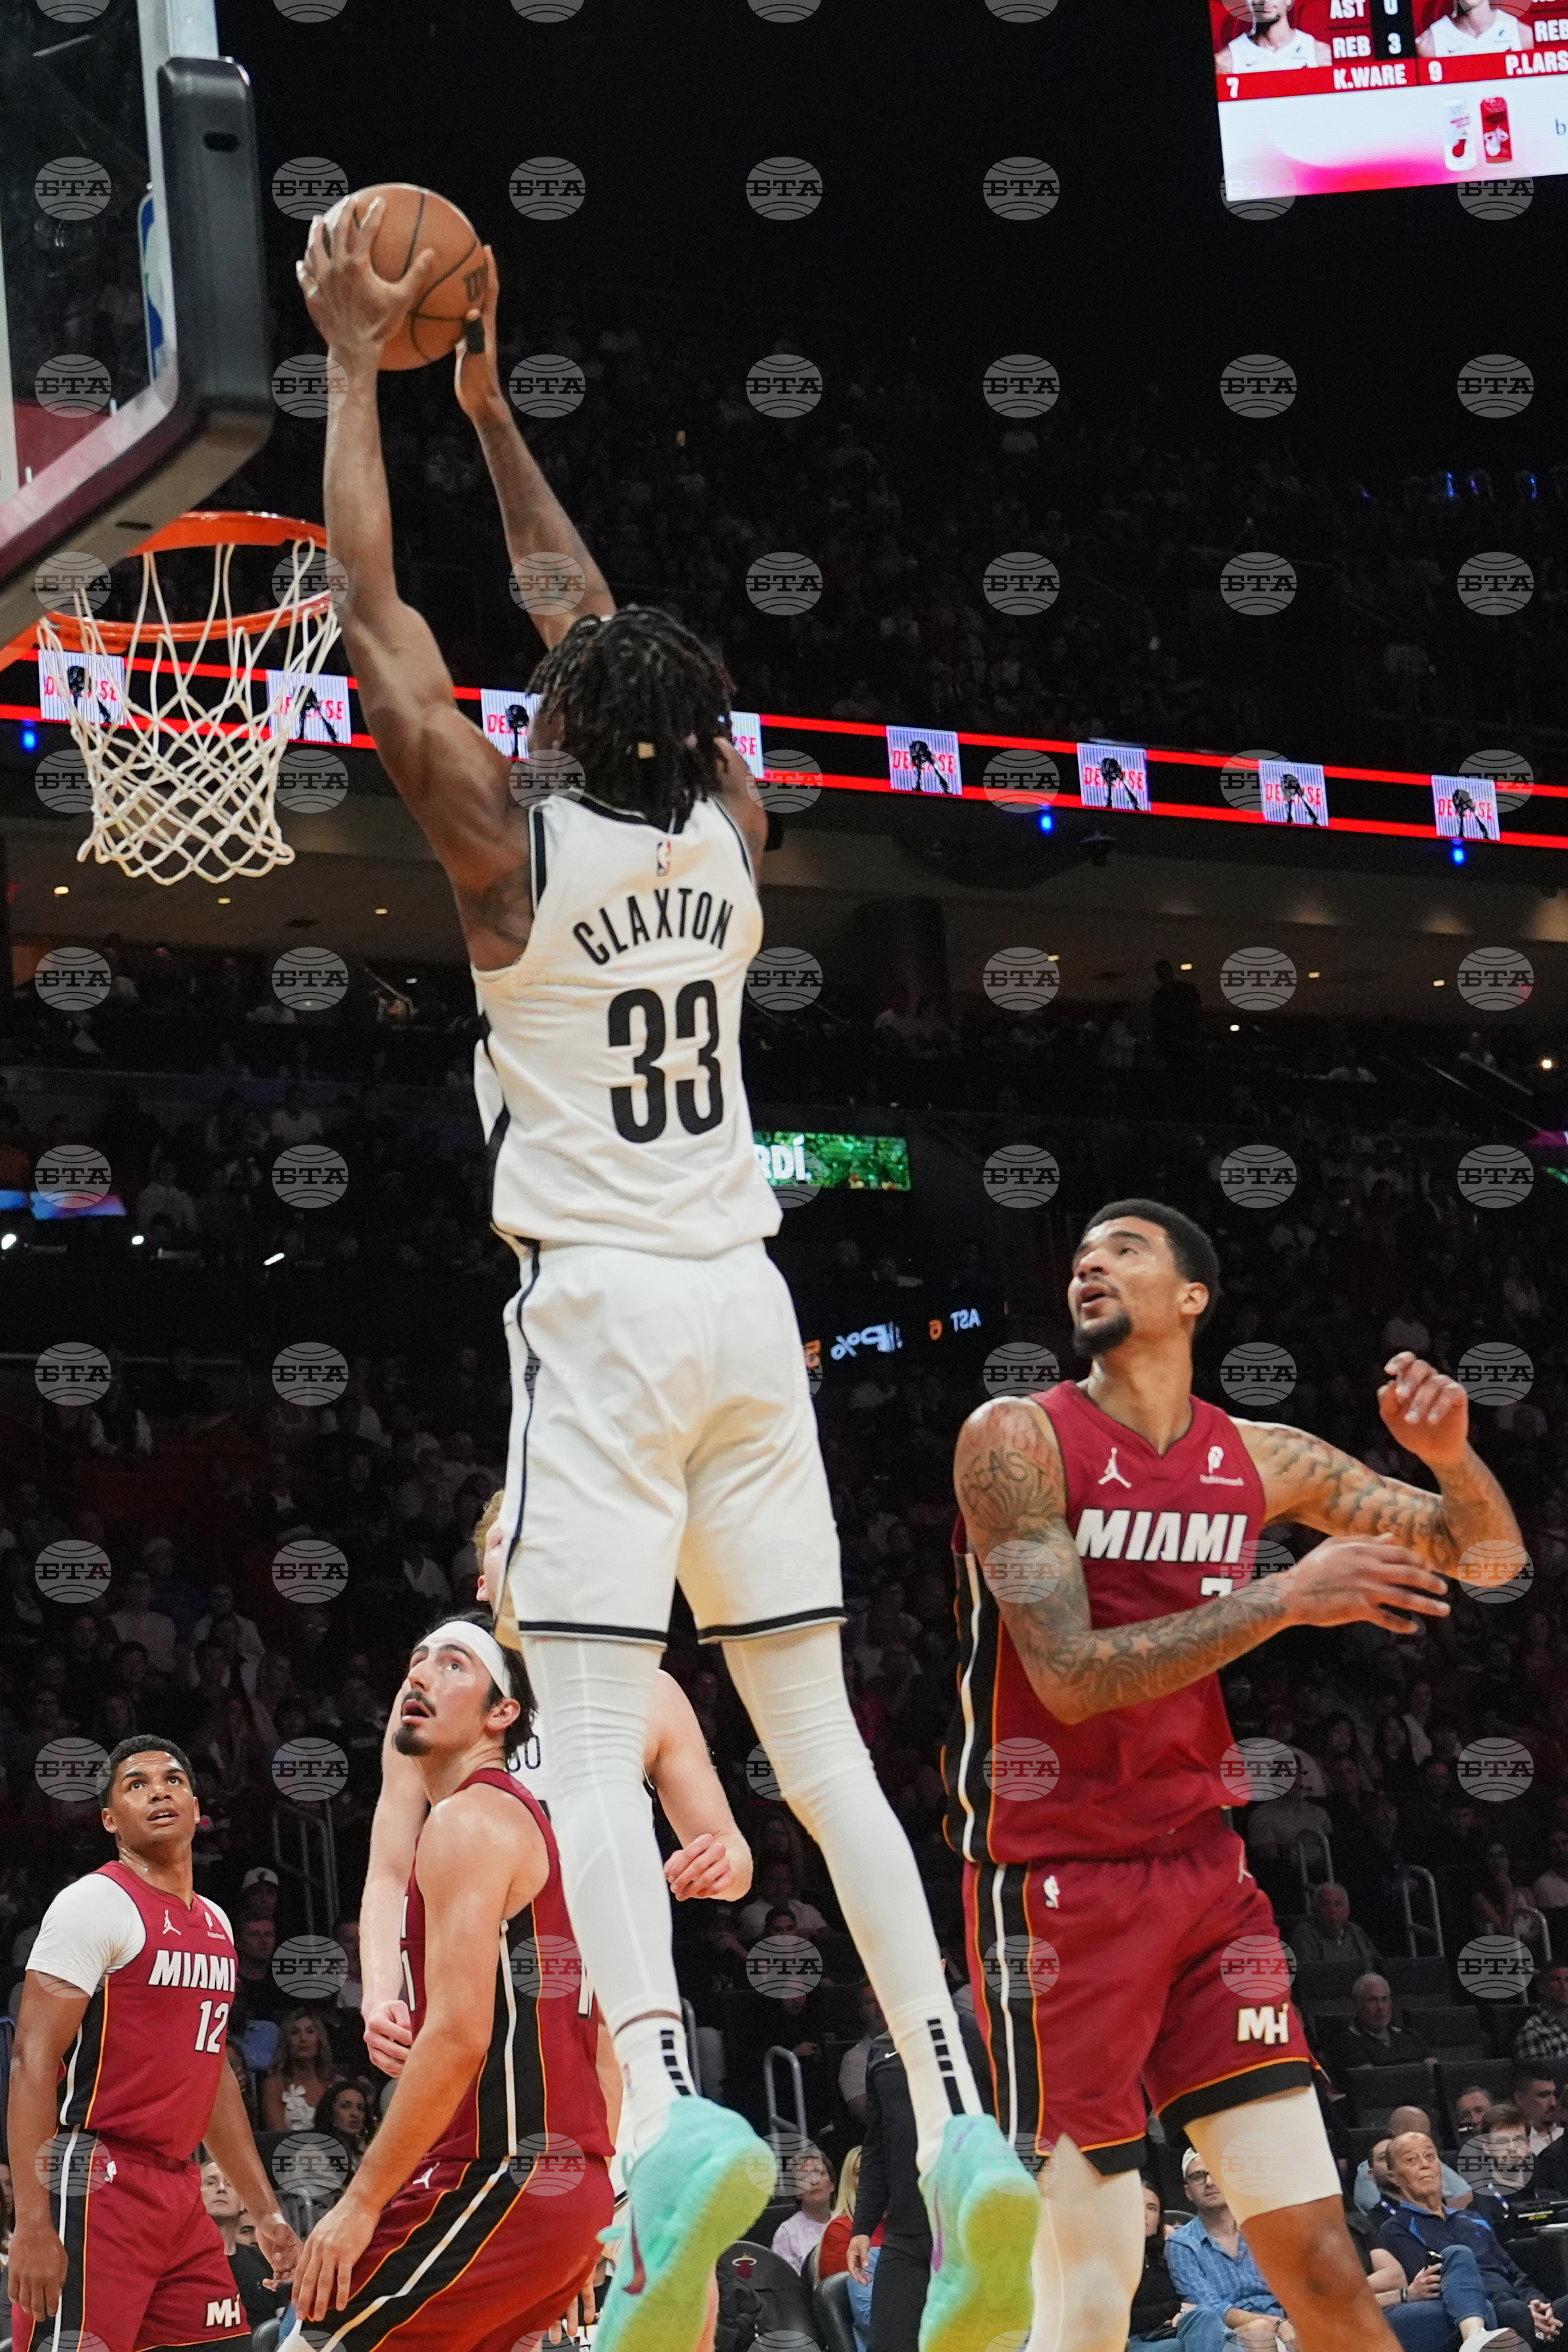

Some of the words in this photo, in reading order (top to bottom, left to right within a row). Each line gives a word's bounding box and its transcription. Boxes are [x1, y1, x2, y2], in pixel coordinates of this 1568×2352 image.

[1330, 0, 1366, 19] AST
[1332, 35, 1371, 59] REB
[1387, 32, 1402, 55] 3
[1534, 18, 1568, 42] REB
[1226, 77, 1239, 98] 7
[1333, 63, 1407, 90] K.WARE
[1428, 61, 1443, 82] 9
[572, 888, 734, 966] CLAXTON
[607, 980, 724, 1144] 33
[1075, 1509, 1248, 1564] MIAMI
[148, 1950, 236, 1992] MIAMI
[195, 2000, 229, 2054] 12
